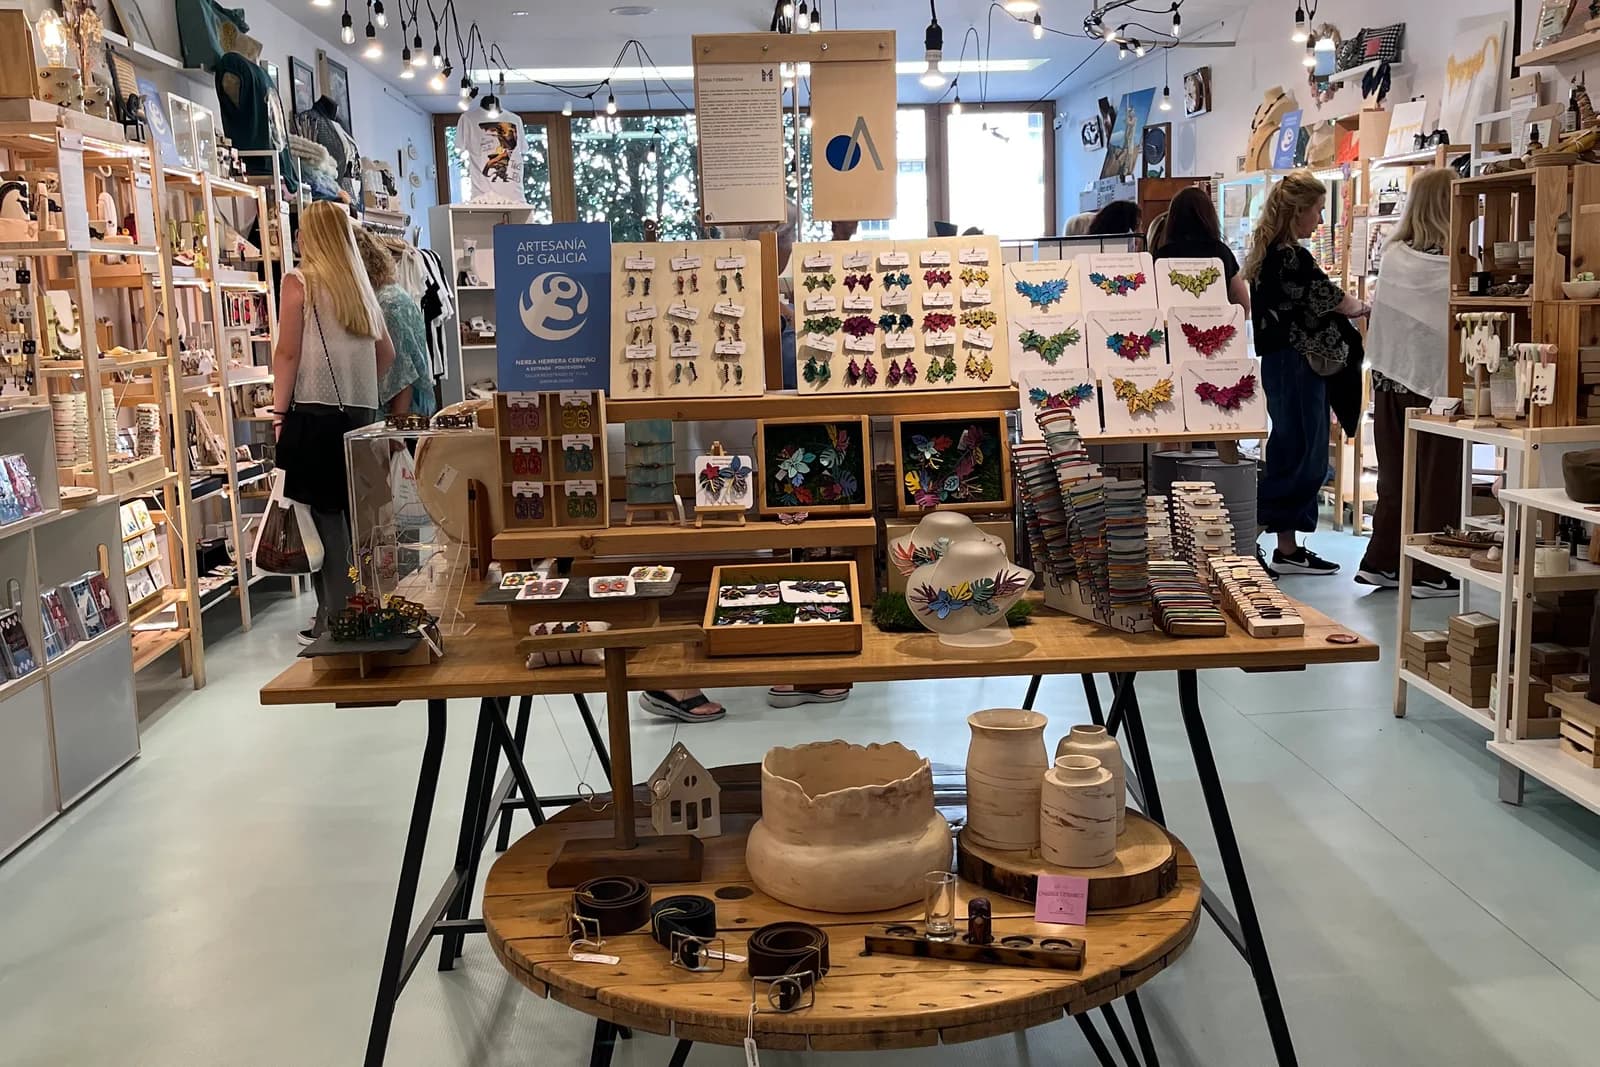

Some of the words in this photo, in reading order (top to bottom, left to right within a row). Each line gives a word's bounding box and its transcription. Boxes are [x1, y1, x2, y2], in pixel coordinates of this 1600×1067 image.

[517, 237, 587, 252] ARTESANÍA
[517, 254, 534, 265] DE
[537, 252, 588, 265] GALICIA
